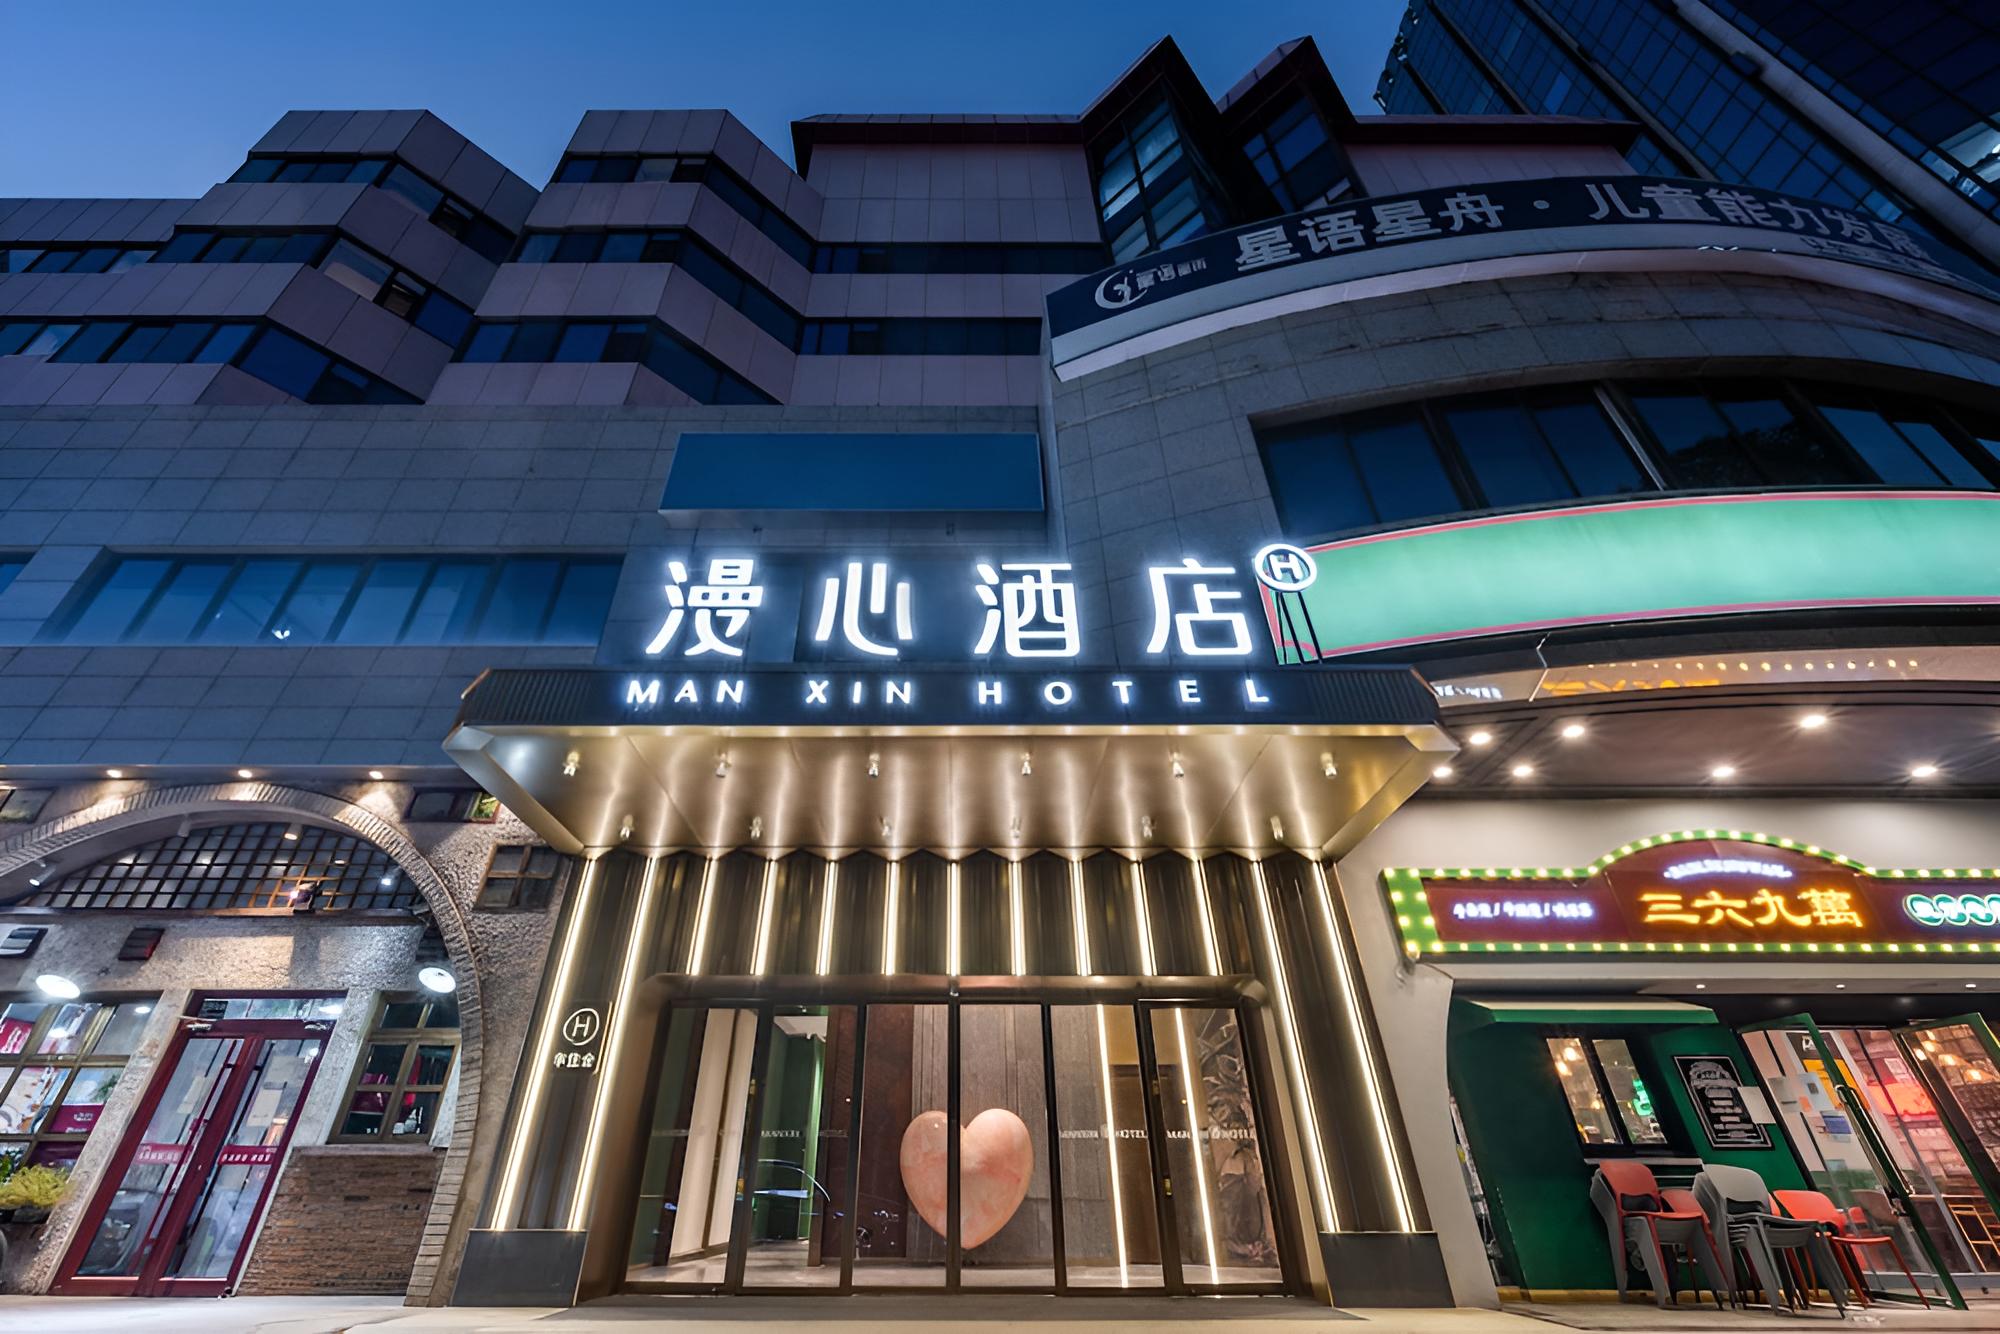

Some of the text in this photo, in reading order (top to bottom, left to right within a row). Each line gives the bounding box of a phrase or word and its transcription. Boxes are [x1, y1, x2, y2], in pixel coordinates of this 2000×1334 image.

[1235, 191, 1505, 271] 星语星舟
[645, 557, 1253, 657] 漫心酒店
[626, 678, 1270, 704] MAN XIN HOTEL
[1640, 888, 1864, 928] 三六九萬
